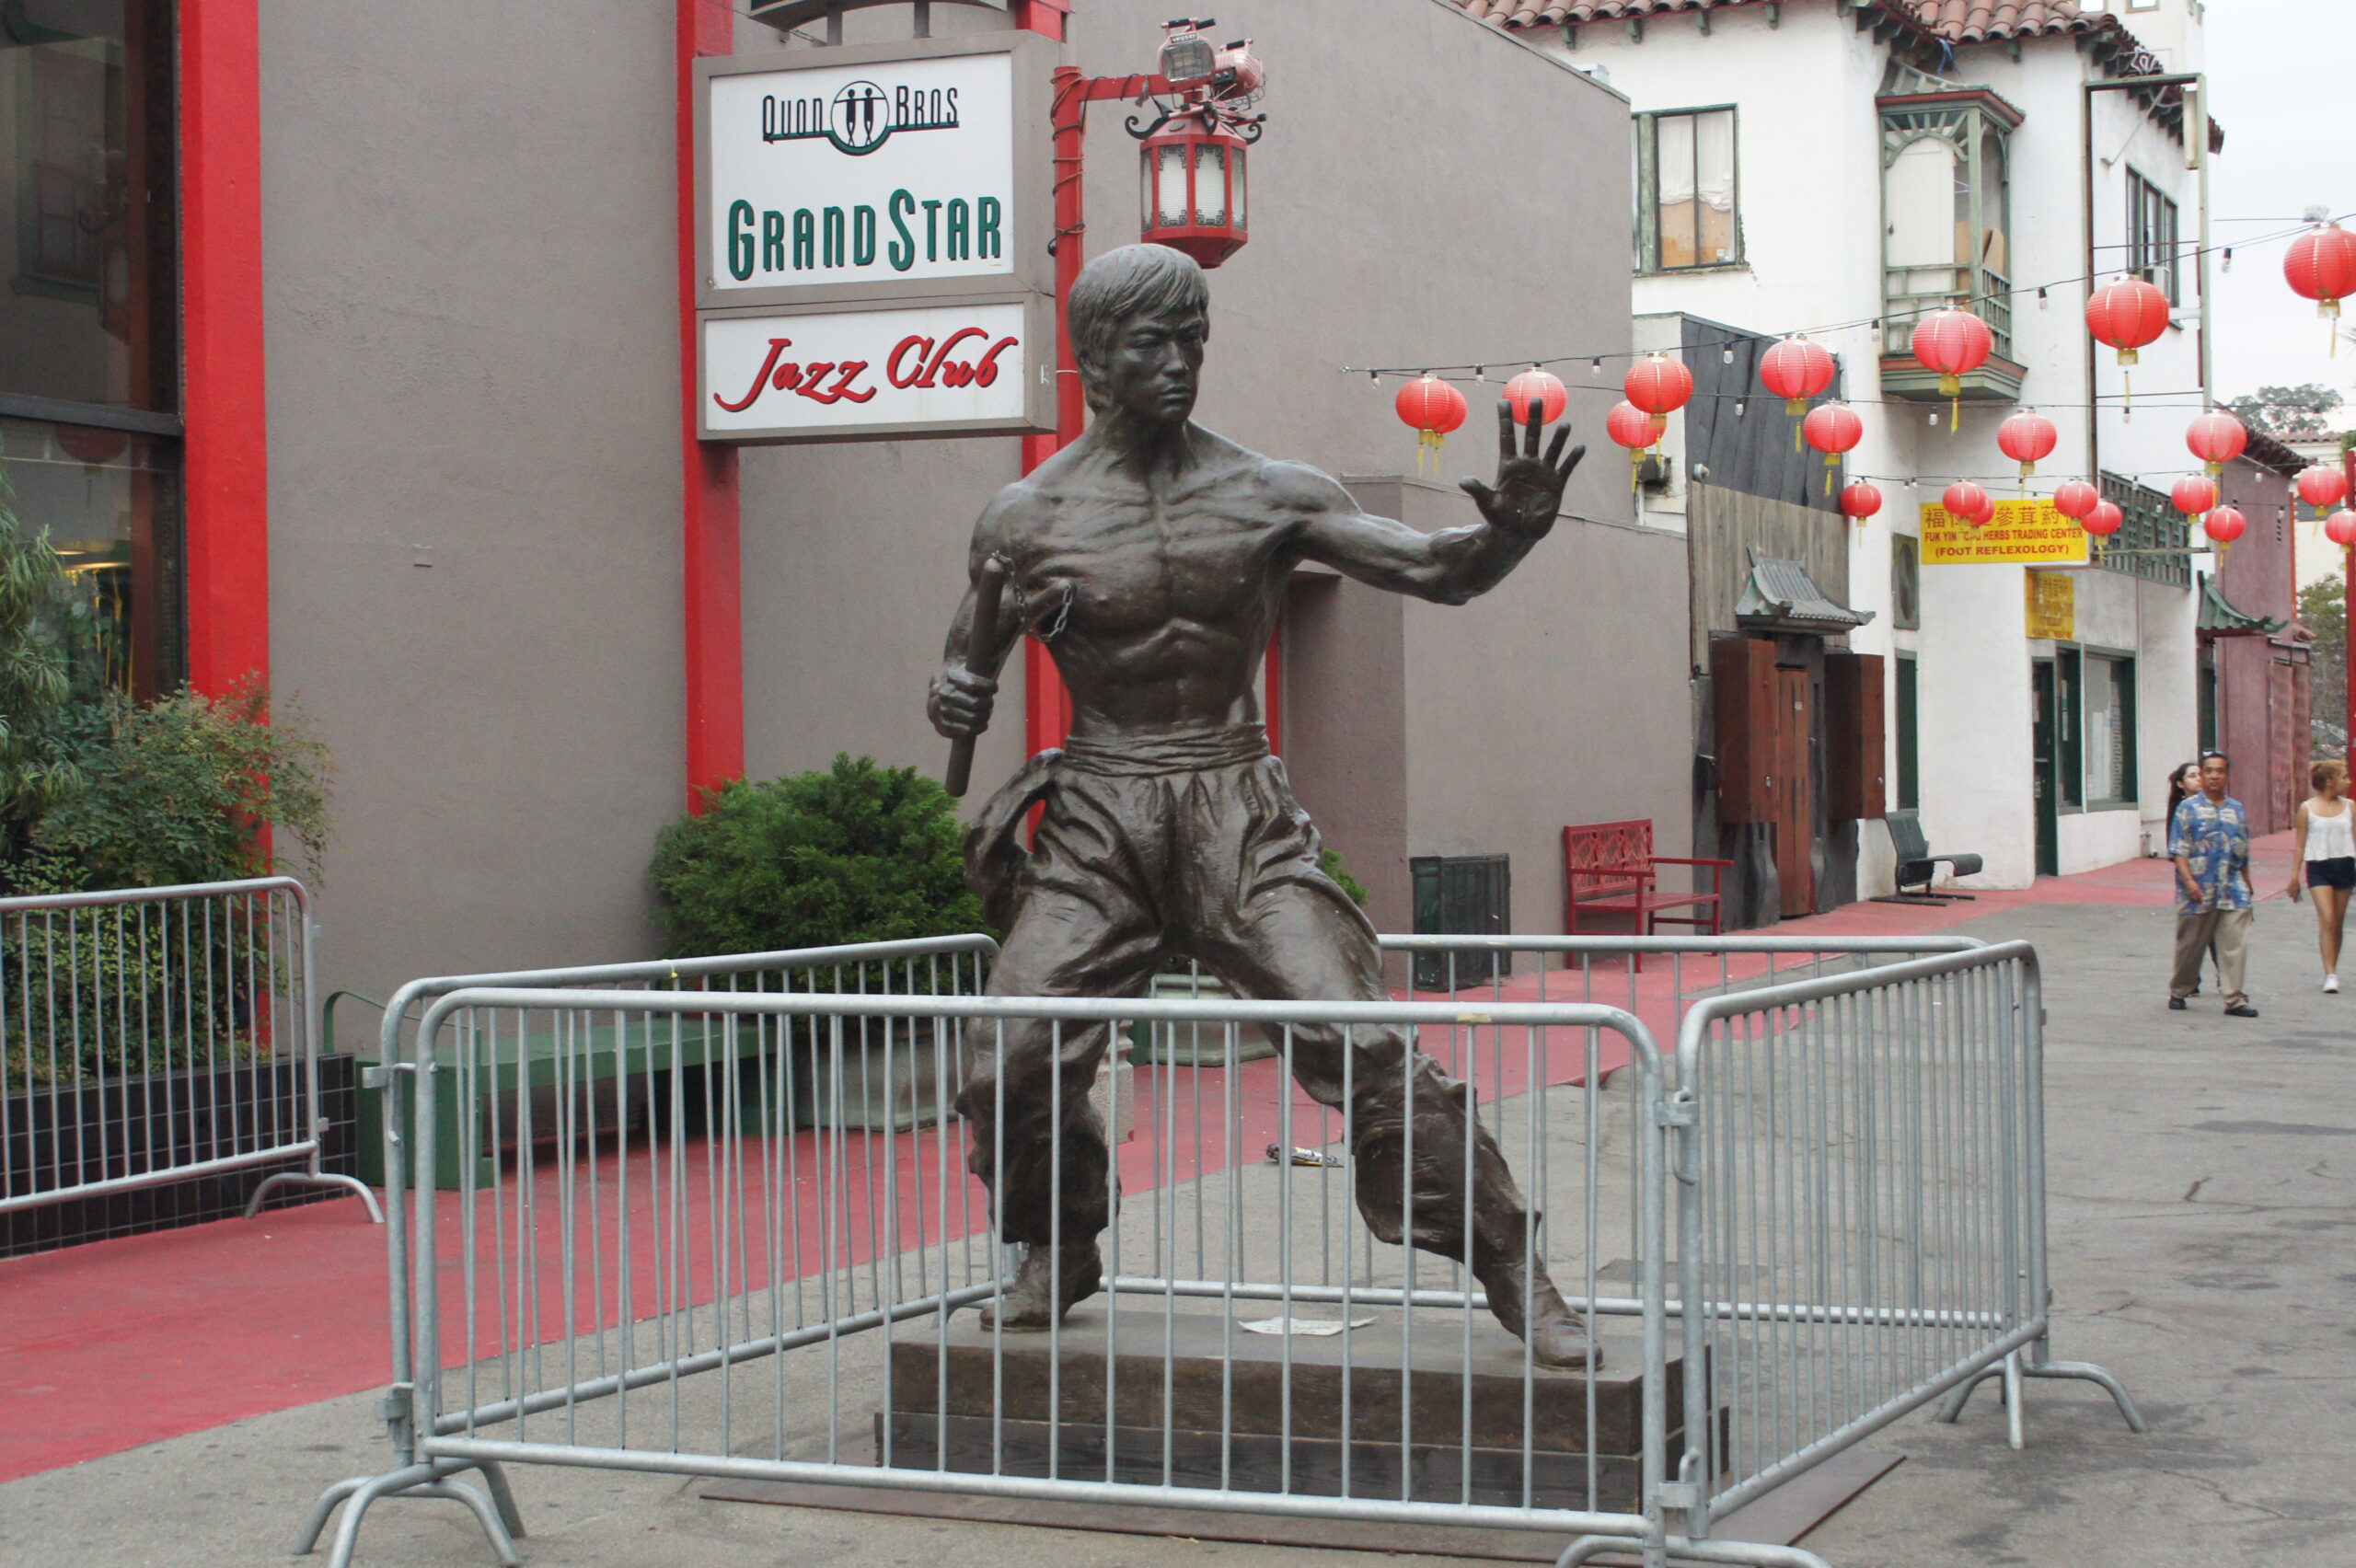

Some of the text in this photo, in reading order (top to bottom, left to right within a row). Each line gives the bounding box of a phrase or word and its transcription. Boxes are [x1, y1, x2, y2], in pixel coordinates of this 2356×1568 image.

[728, 188, 1001, 282] GRAND STAR
[713, 326, 1019, 413] Jazz Club
[1924, 531, 1941, 542] FUK
[1943, 530, 1958, 541] YIN
[1983, 529, 2011, 541] HERBS
[2012, 527, 2049, 540] TRADING
[2050, 527, 2084, 539] CENTER
[1935, 544, 2069, 559] (FOOT REFLEXOLOGY)
